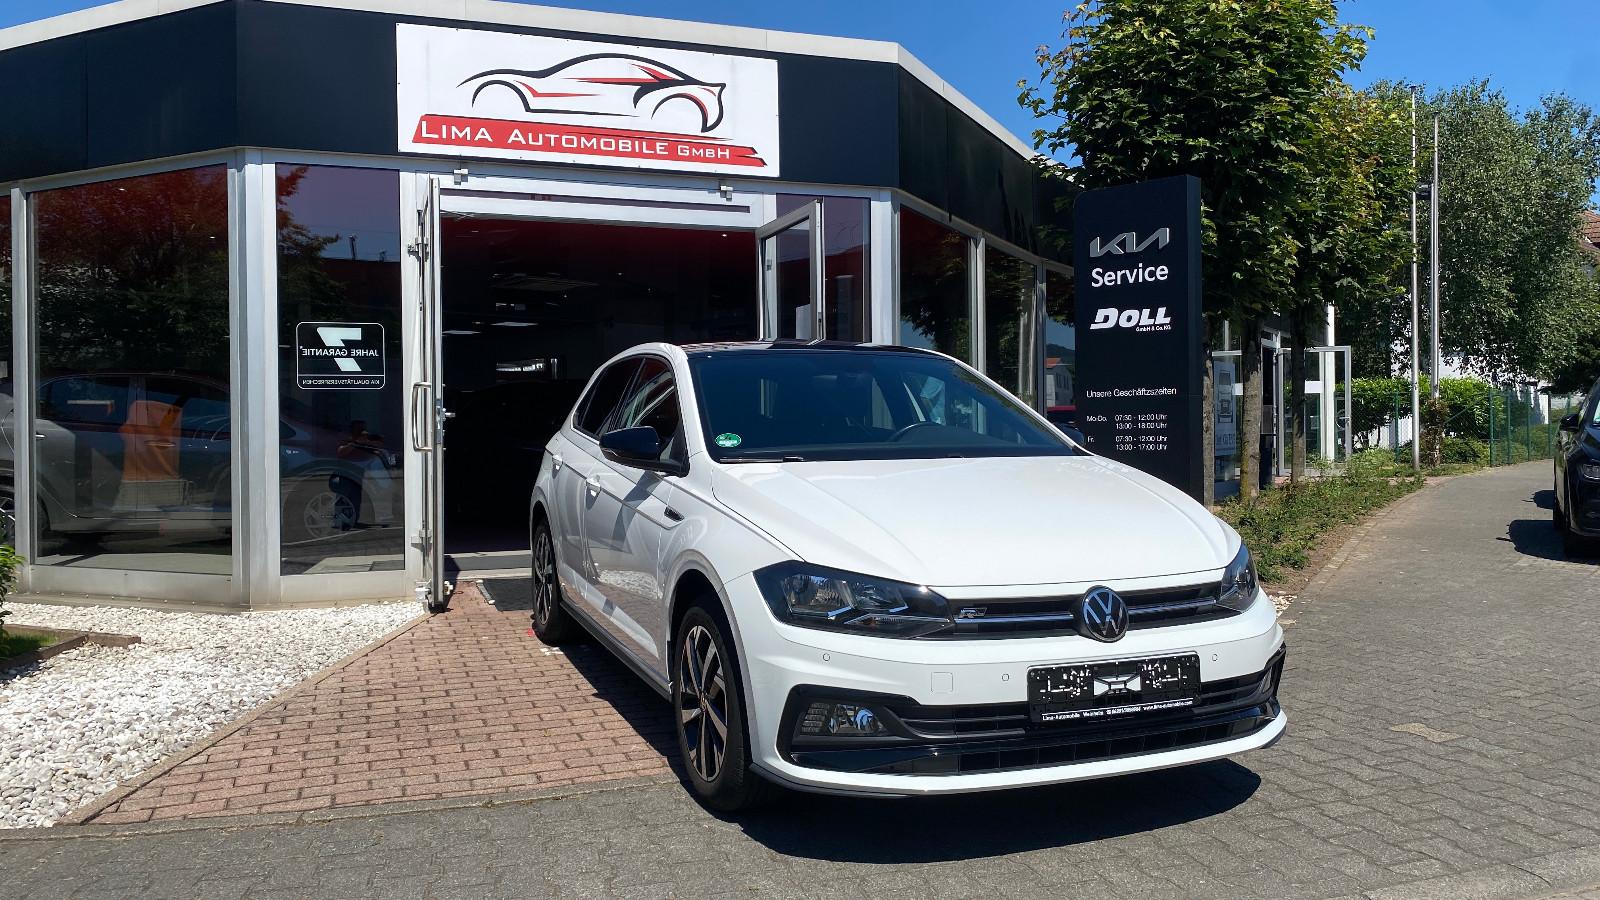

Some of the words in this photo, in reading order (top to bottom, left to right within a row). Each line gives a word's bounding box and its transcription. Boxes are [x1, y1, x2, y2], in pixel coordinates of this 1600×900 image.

[1090, 228, 1170, 257] KIA
[1091, 262, 1169, 287] Service
[1086, 390, 1112, 398] Unsere
[1114, 414, 1132, 422] 07:30
[1155, 413, 1168, 421] Uhr
[1115, 422, 1133, 430] 13:00
[1115, 435, 1133, 443] 07:30
[1116, 443, 1133, 451] 13:00
[1138, 443, 1156, 451] 17:00
[1156, 443, 1168, 451] Uhr
